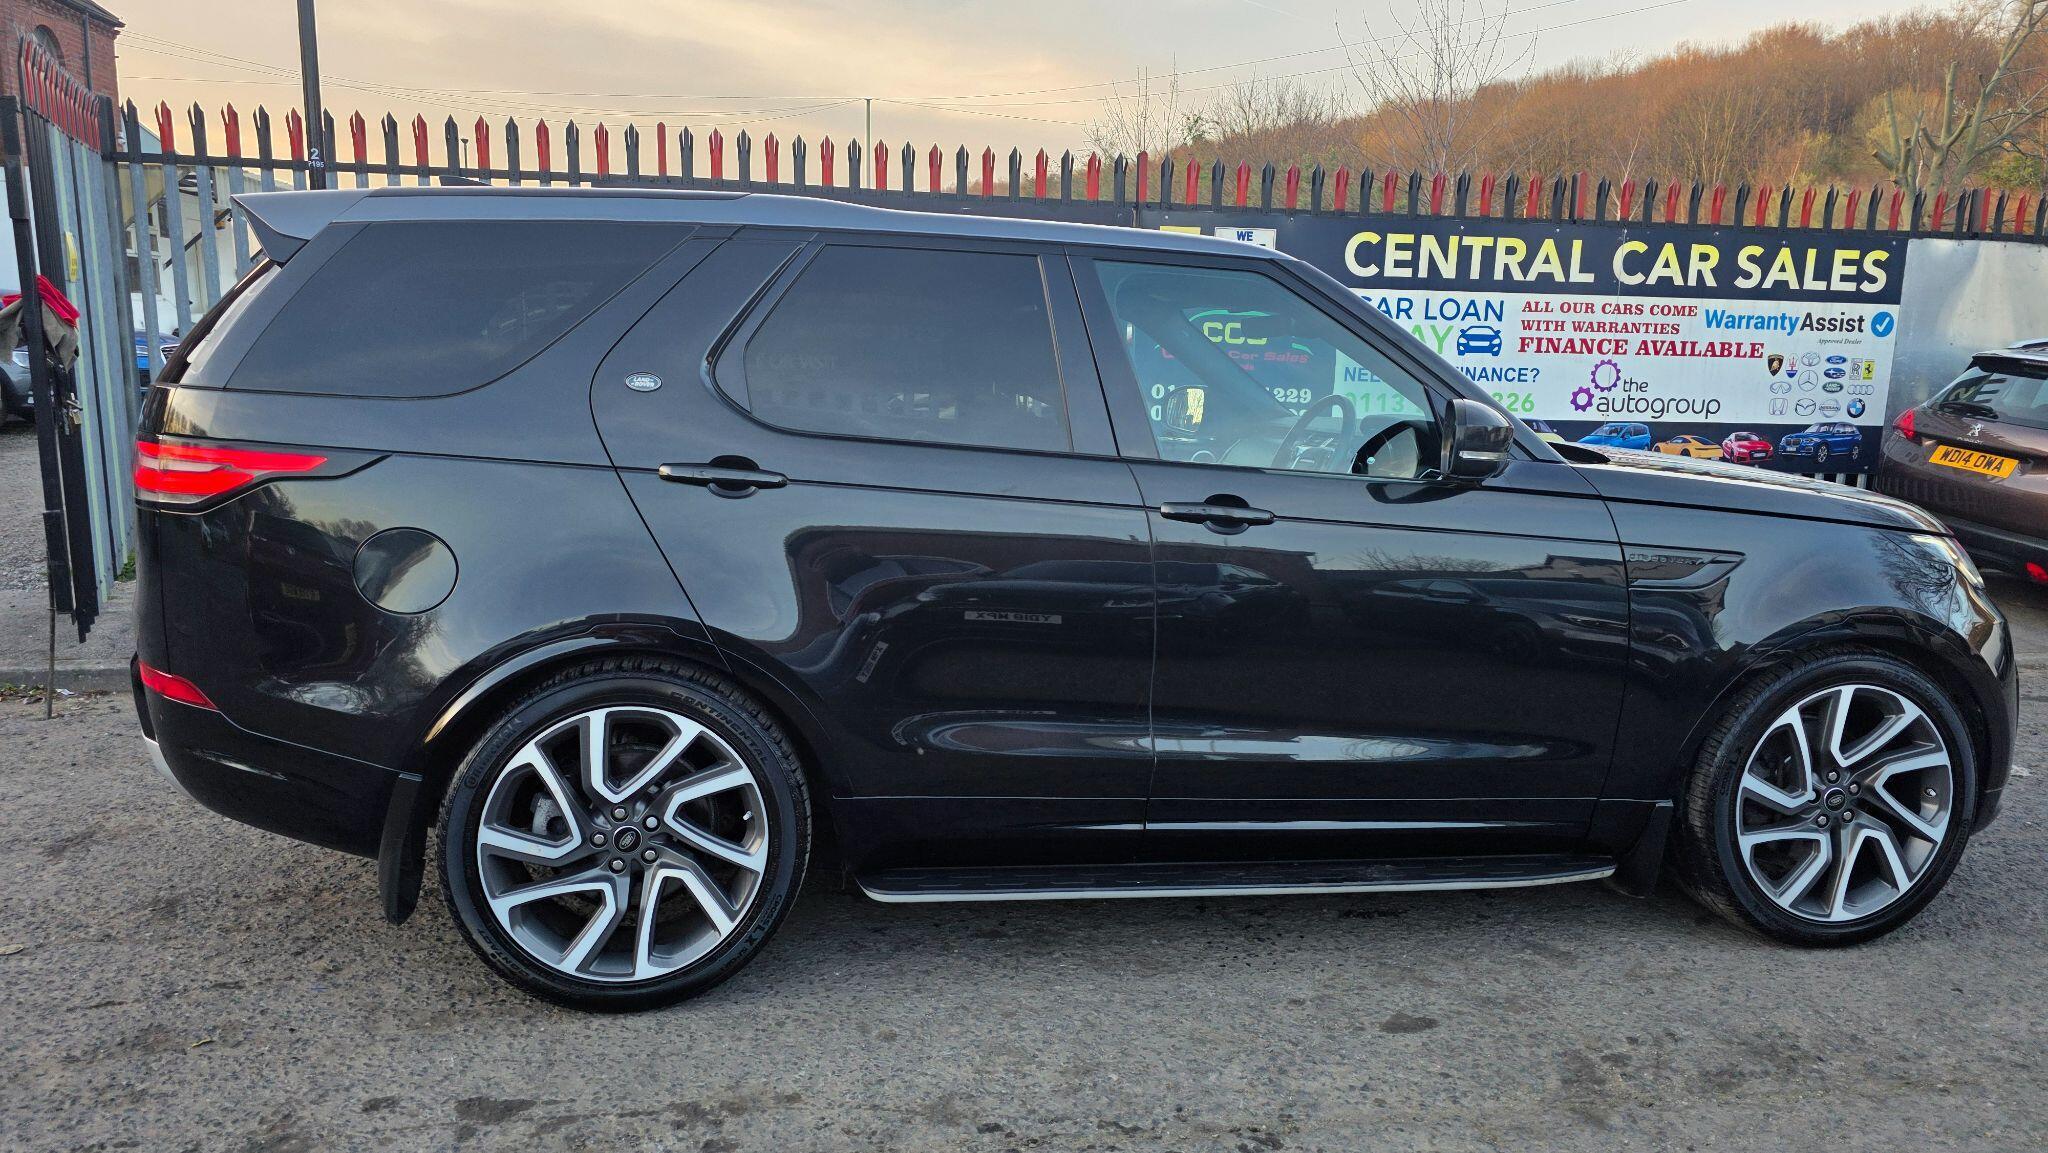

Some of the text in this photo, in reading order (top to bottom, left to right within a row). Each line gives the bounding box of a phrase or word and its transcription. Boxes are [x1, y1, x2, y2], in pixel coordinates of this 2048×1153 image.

[310, 147, 320, 160] 2
[1237, 231, 1254, 241] WE
[1344, 231, 1890, 294] CENTRAL CAR SALES
[1424, 297, 1505, 322] LOAN
[1521, 301, 1698, 317] ALL OUR CARS COME
[1202, 321, 1268, 345] CC
[1521, 319, 1681, 335] WITH WARRANTIES
[1518, 336, 1765, 359] FINANCE AVAILABLE
[1264, 352, 1309, 363] Sales
[1623, 377, 1649, 393] the
[1596, 394, 1721, 419] autogroup
[1939, 448, 2004, 473] WD14 OWA
